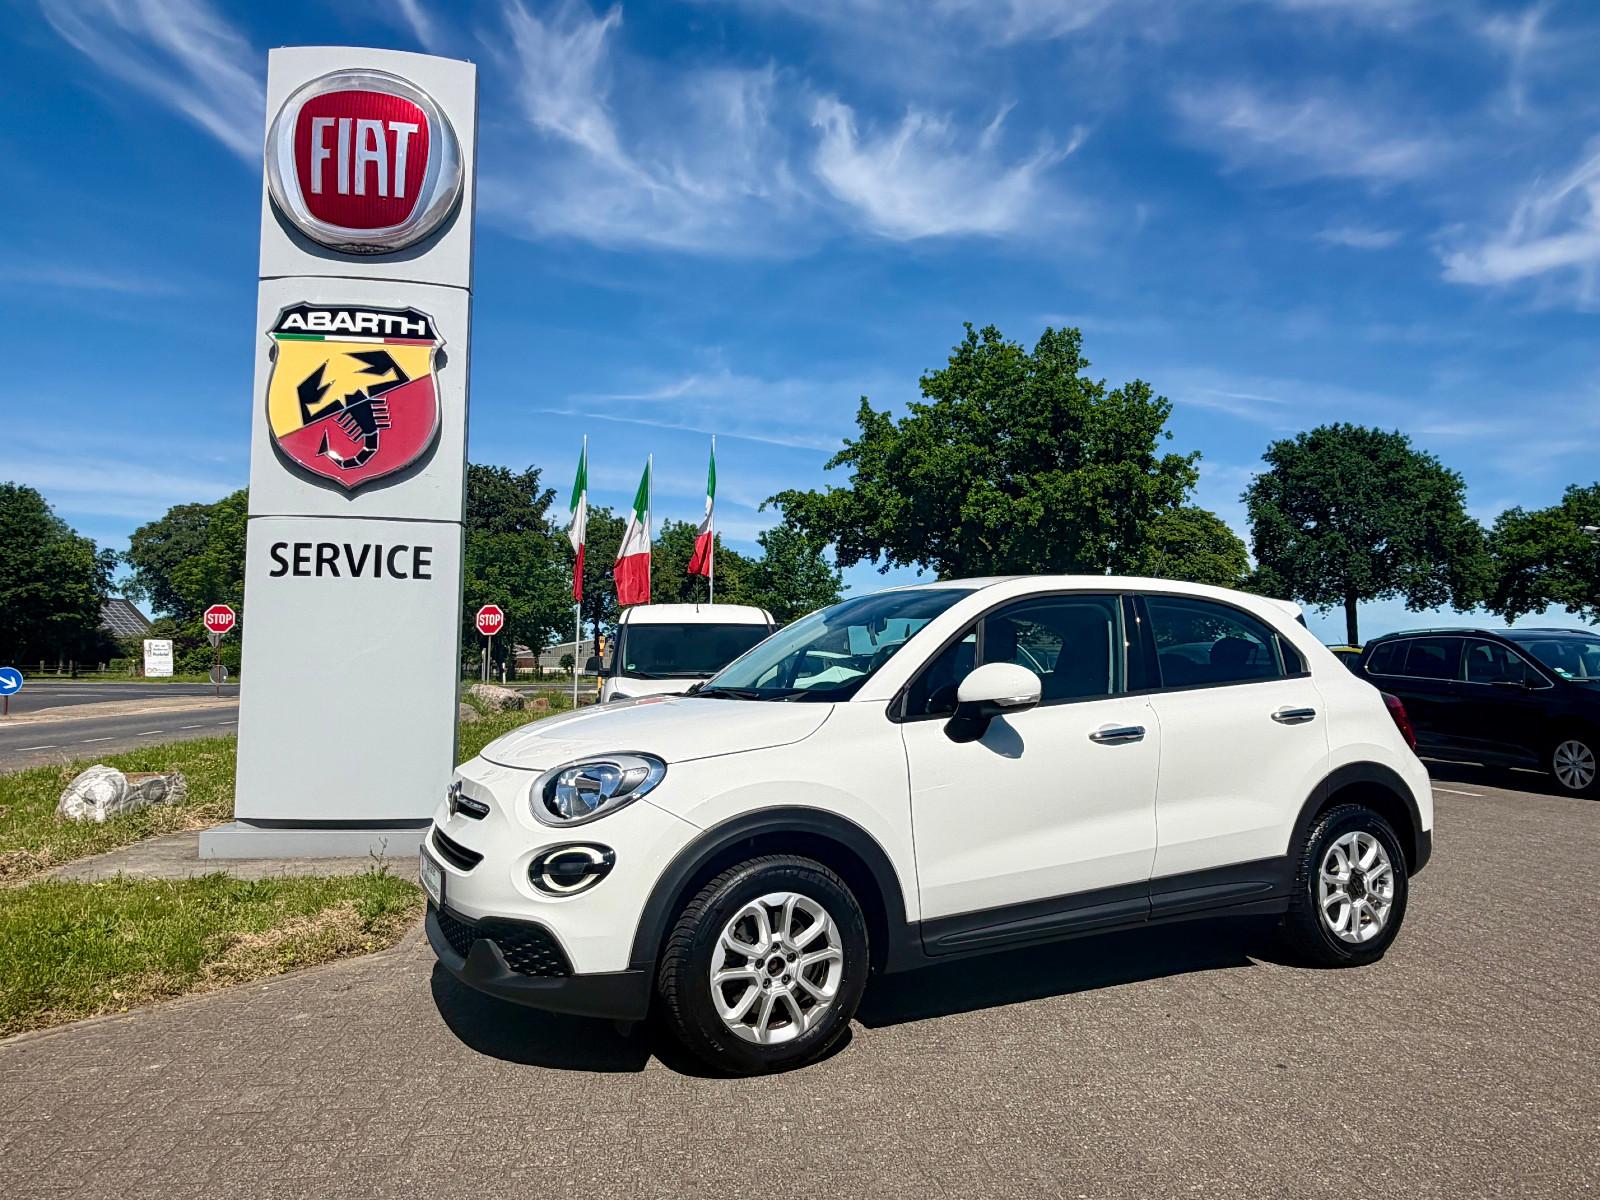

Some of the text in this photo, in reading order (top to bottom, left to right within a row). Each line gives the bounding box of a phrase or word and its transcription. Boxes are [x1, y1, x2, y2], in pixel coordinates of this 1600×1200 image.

[311, 117, 419, 198] FIAT
[281, 311, 426, 336] ABARTH
[269, 541, 433, 580] SERVICE
[207, 613, 232, 625] STOP
[479, 614, 500, 626] STOP
